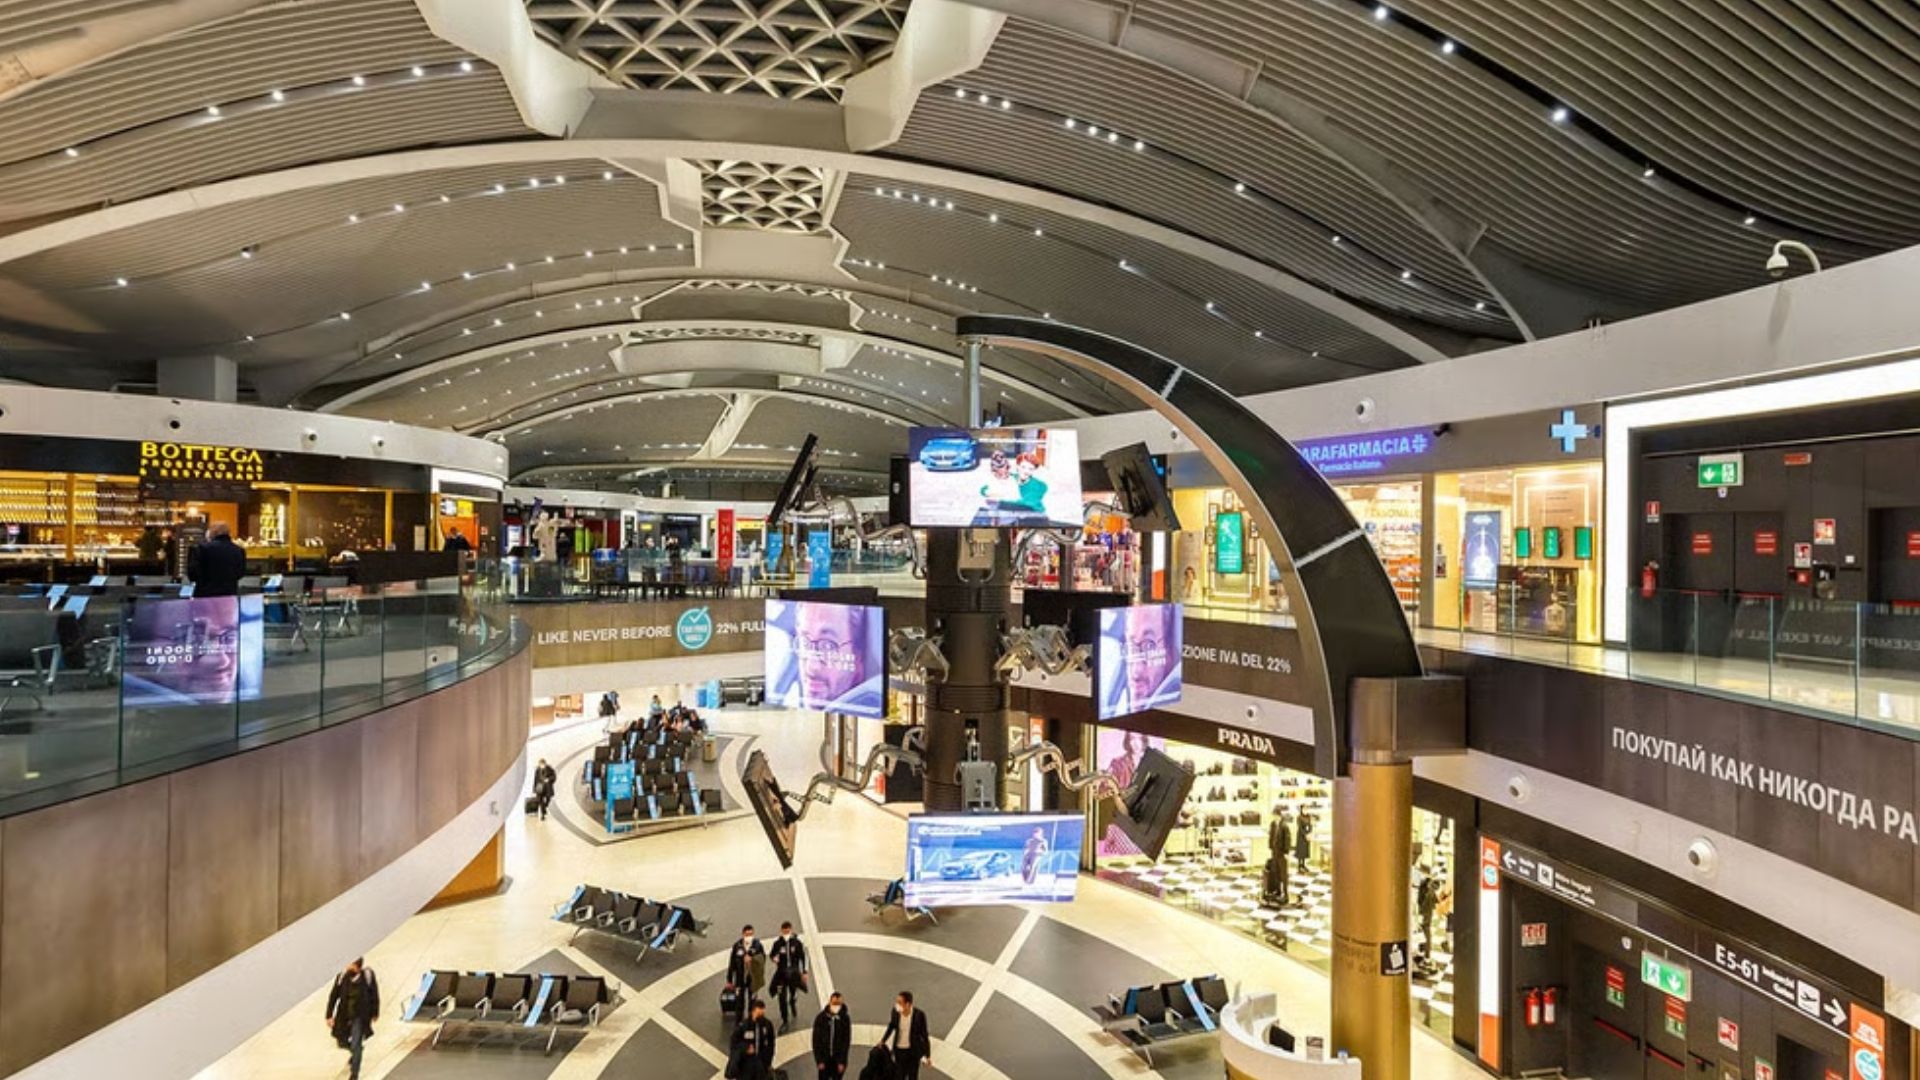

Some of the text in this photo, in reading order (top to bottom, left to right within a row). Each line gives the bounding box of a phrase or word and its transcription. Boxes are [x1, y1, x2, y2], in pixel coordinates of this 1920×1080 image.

[141, 441, 263, 464] BOTTEGA
[1300, 436, 1412, 461] ARAFARMACIA
[140, 458, 263, 473] PROSECCO BAR
[160, 469, 263, 480] RESTAURANT
[538, 630, 569, 645] LIKE
[573, 627, 619, 642] NEVER
[621, 624, 672, 640] BEFORE
[716, 619, 766, 635] 22% FULL
[1220, 649, 1239, 665] IVA
[1241, 652, 1264, 669] DEL
[1267, 655, 1292, 674] 22%
[1217, 728, 1277, 757] PRADA
[1612, 727, 1919, 845] ПОКУПАЙ КАК НИКОГДА РА
